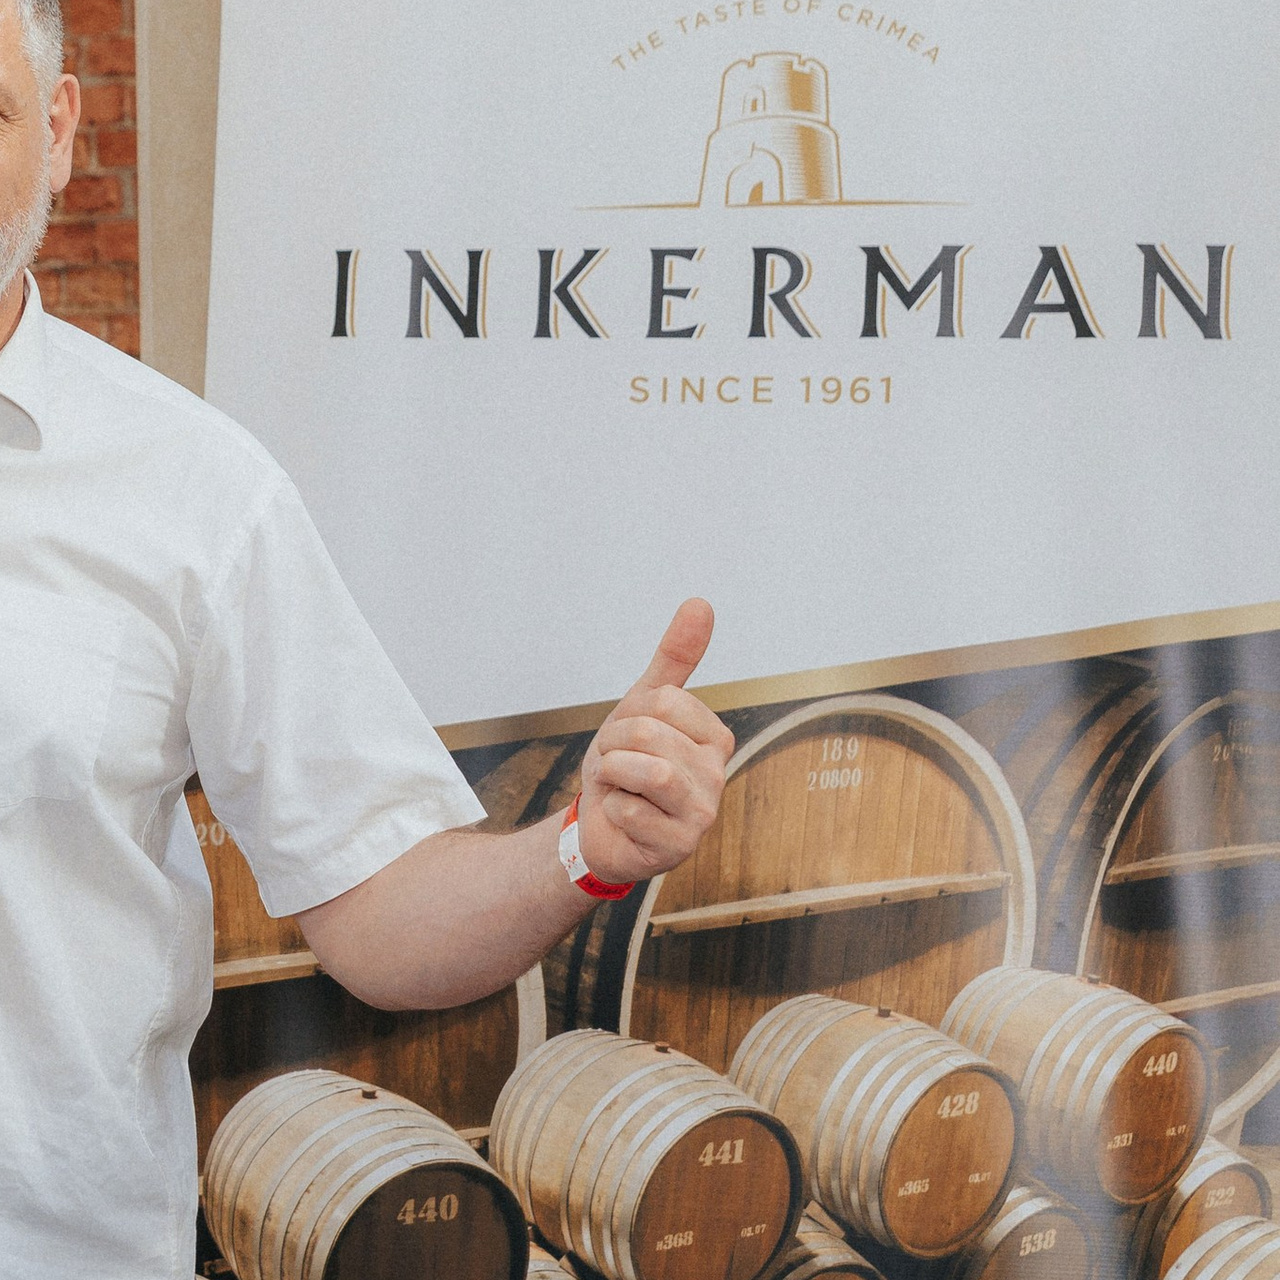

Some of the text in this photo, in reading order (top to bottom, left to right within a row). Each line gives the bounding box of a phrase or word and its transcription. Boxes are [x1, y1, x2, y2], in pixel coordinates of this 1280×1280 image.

[611, 30, 663, 72] THE
[837, 2, 941, 65] CRIMEA
[329, 243, 1237, 341] INKERMAN
[629, 375, 896, 405] SINCE 1961
[822, 735, 860, 762] 189
[1142, 1050, 1179, 1078] 440
[936, 1090, 981, 1120] 428
[698, 1138, 745, 1168] 441
[396, 1193, 460, 1226] 440
[1019, 1228, 1057, 1257] 538
